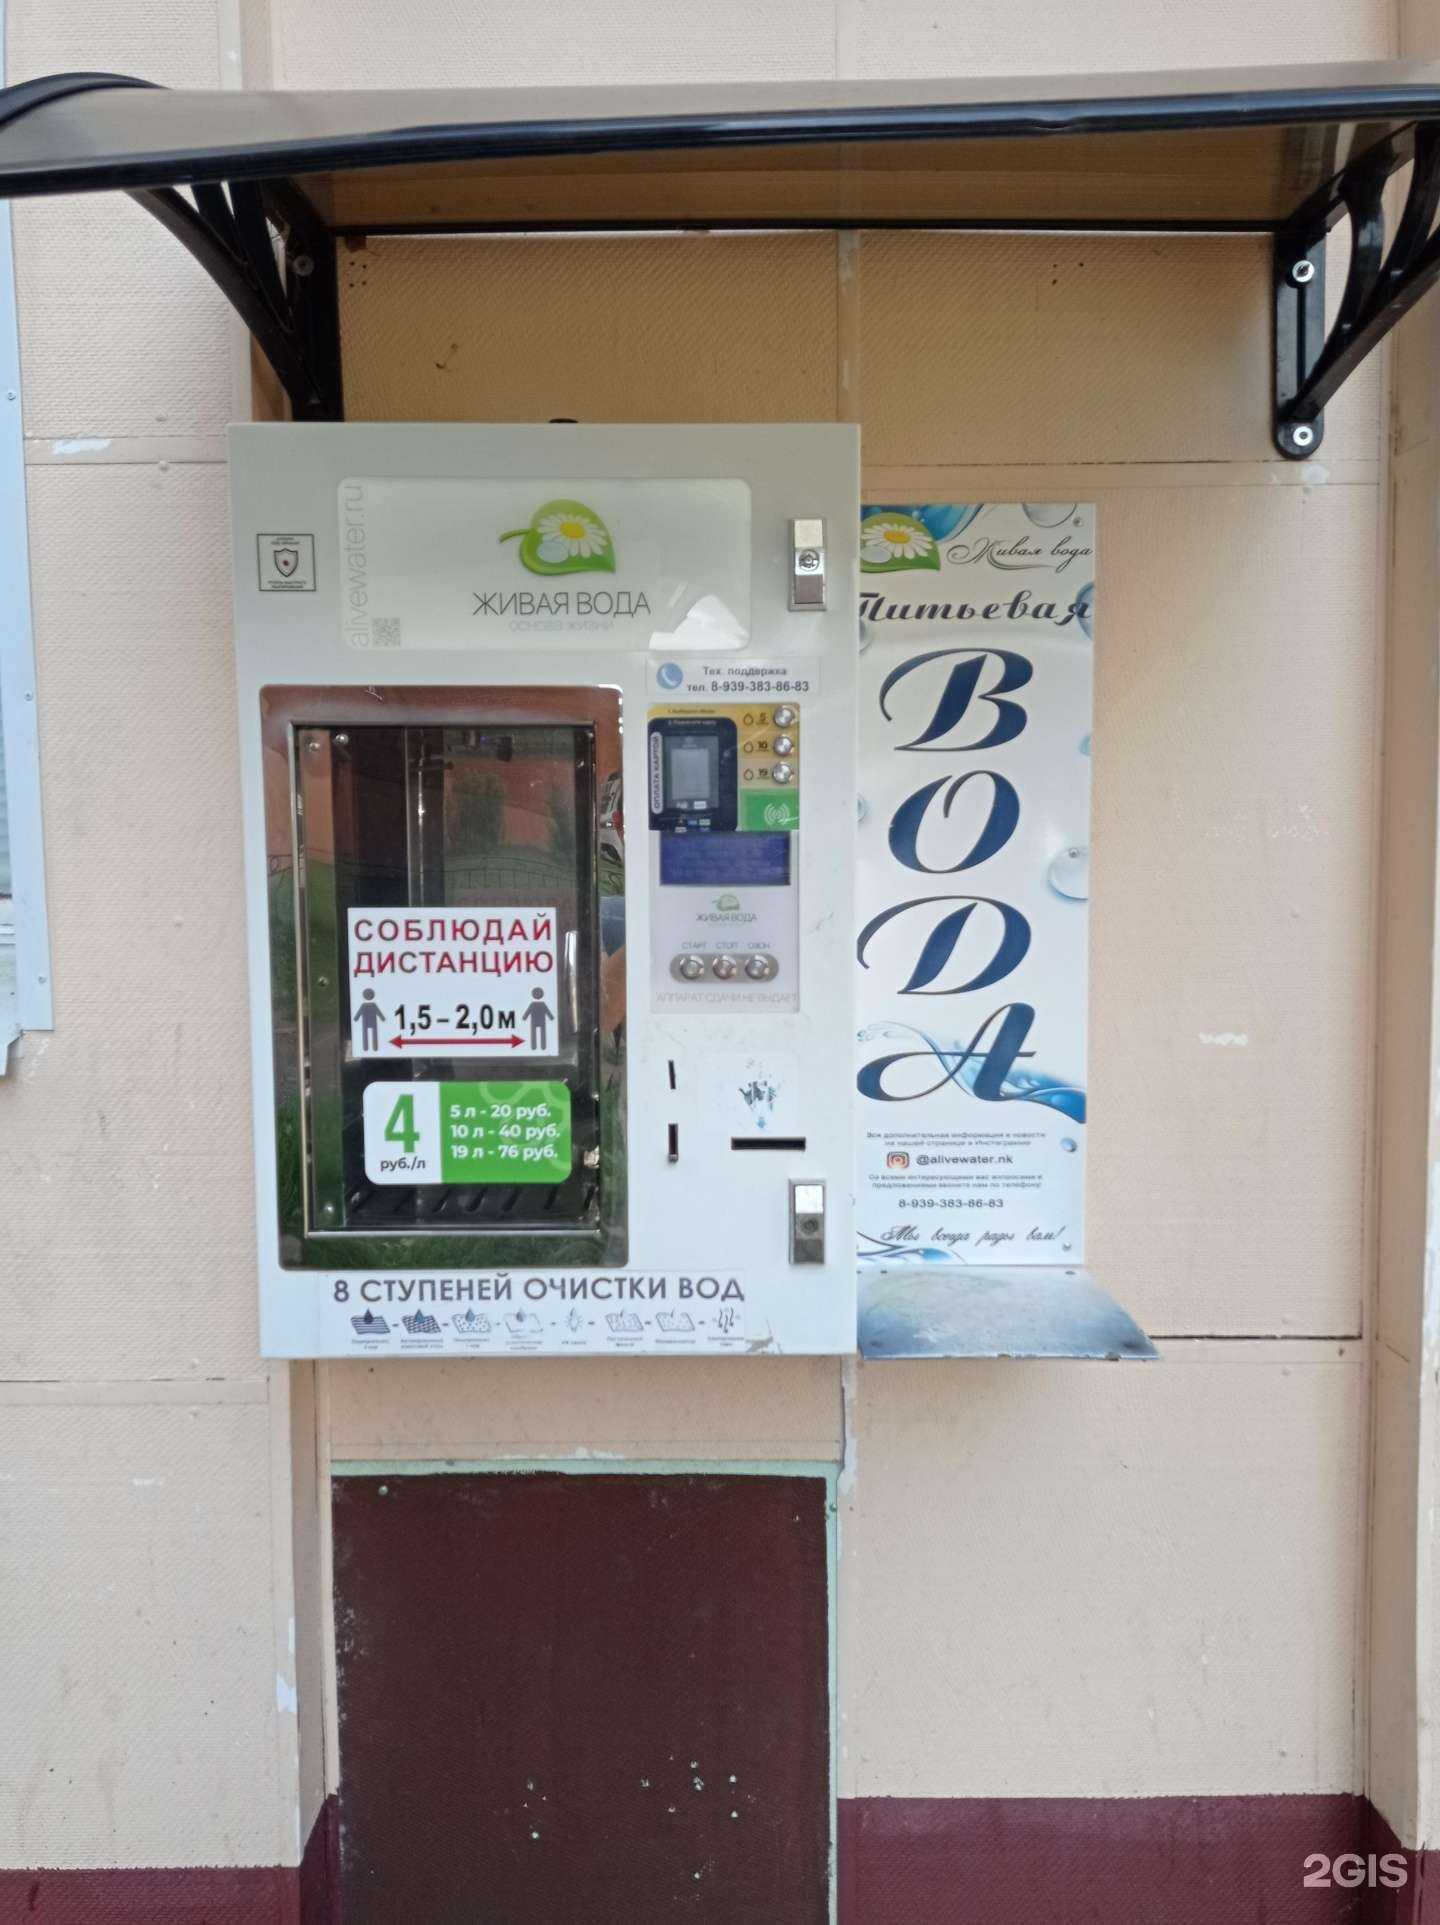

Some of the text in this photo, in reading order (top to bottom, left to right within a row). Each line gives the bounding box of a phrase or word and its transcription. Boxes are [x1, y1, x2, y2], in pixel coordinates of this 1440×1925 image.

[946, 536, 1093, 573] Живая вода
[344, 484, 369, 648] alivewater.ru
[473, 591, 651, 618] ЖИВАЯ ВОДА
[860, 590, 1092, 626] Питьевая
[727, 667, 787, 677] поддержка
[711, 681, 809, 692] 8-939-383-86-83
[758, 741, 768, 749] 10
[696, 913, 757, 923] ЖИВАЯ ВОДА
[354, 913, 551, 945] СОБЛЮДАЙ
[353, 951, 553, 977] ДИСТАНЦИЮ
[450, 1105, 460, 1118] 5
[464, 1108, 475, 1118] л
[491, 1105, 511, 1118] 20
[516, 1104, 551, 1121] руб.
[384, 1094, 420, 1153] 4
[452, 1125, 468, 1138] 10
[472, 1128, 483, 1138] л
[500, 1125, 521, 1138] 40
[526, 1124, 560, 1141] руб.
[452, 1145, 468, 1159] 19
[472, 1149, 483, 1159] л
[499, 1145, 518, 1159] 76
[523, 1144, 558, 1162] руб.
[380, 1157, 426, 1172] руб./л
[899, 1199, 1004, 1208] 8-939-383-86-83
[333, 1272, 745, 1303] 8 СТУПЕНЕЙ ОЧИСТКИ ВОД
